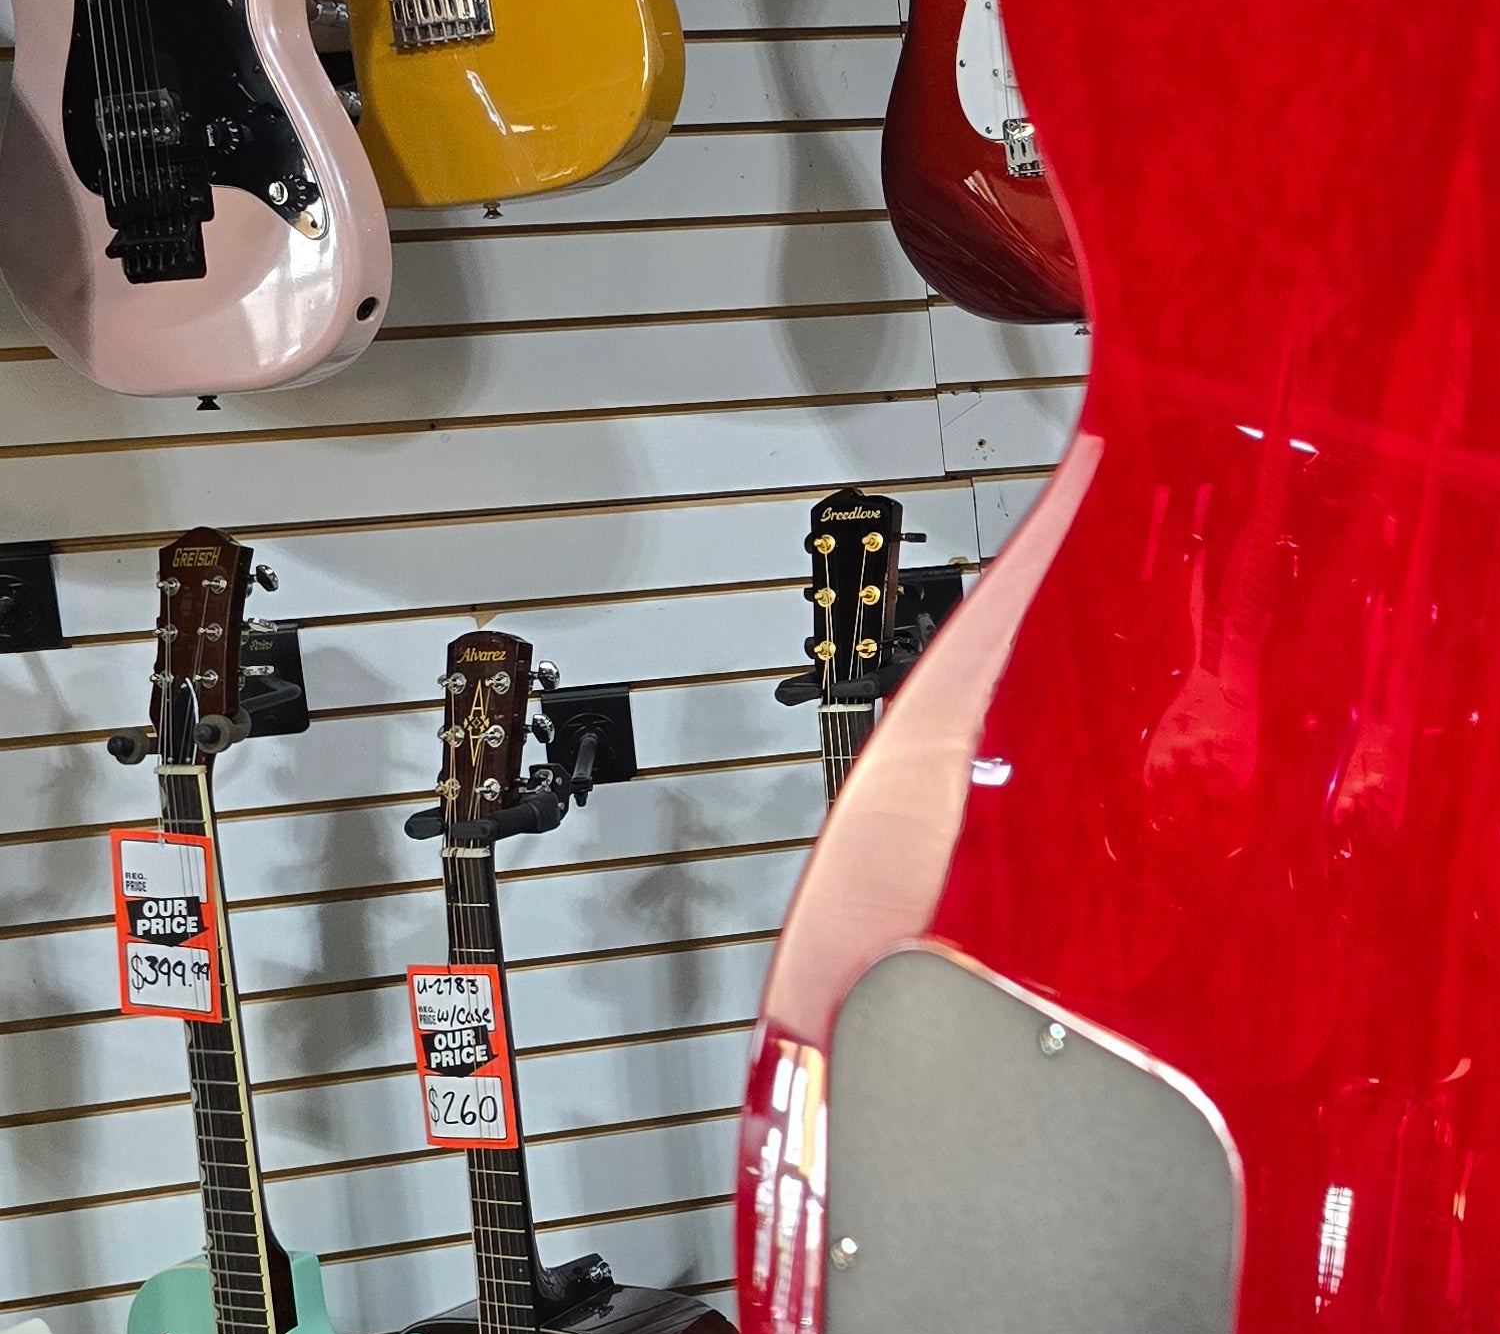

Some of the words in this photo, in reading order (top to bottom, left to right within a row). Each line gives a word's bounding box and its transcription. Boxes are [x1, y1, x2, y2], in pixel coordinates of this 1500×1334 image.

[820, 505, 882, 523] Breedlove
[172, 546, 222, 567] GRETSCH
[456, 647, 507, 664] Alvarez
[125, 880, 148, 893] PRICE
[142, 899, 189, 919] OUR
[136, 916, 199, 937] PRICE
[131, 951, 211, 994] $399.99
[433, 1028, 477, 1051] OUR
[430, 1044, 489, 1069] PRICE
[428, 1084, 499, 1127] $260
